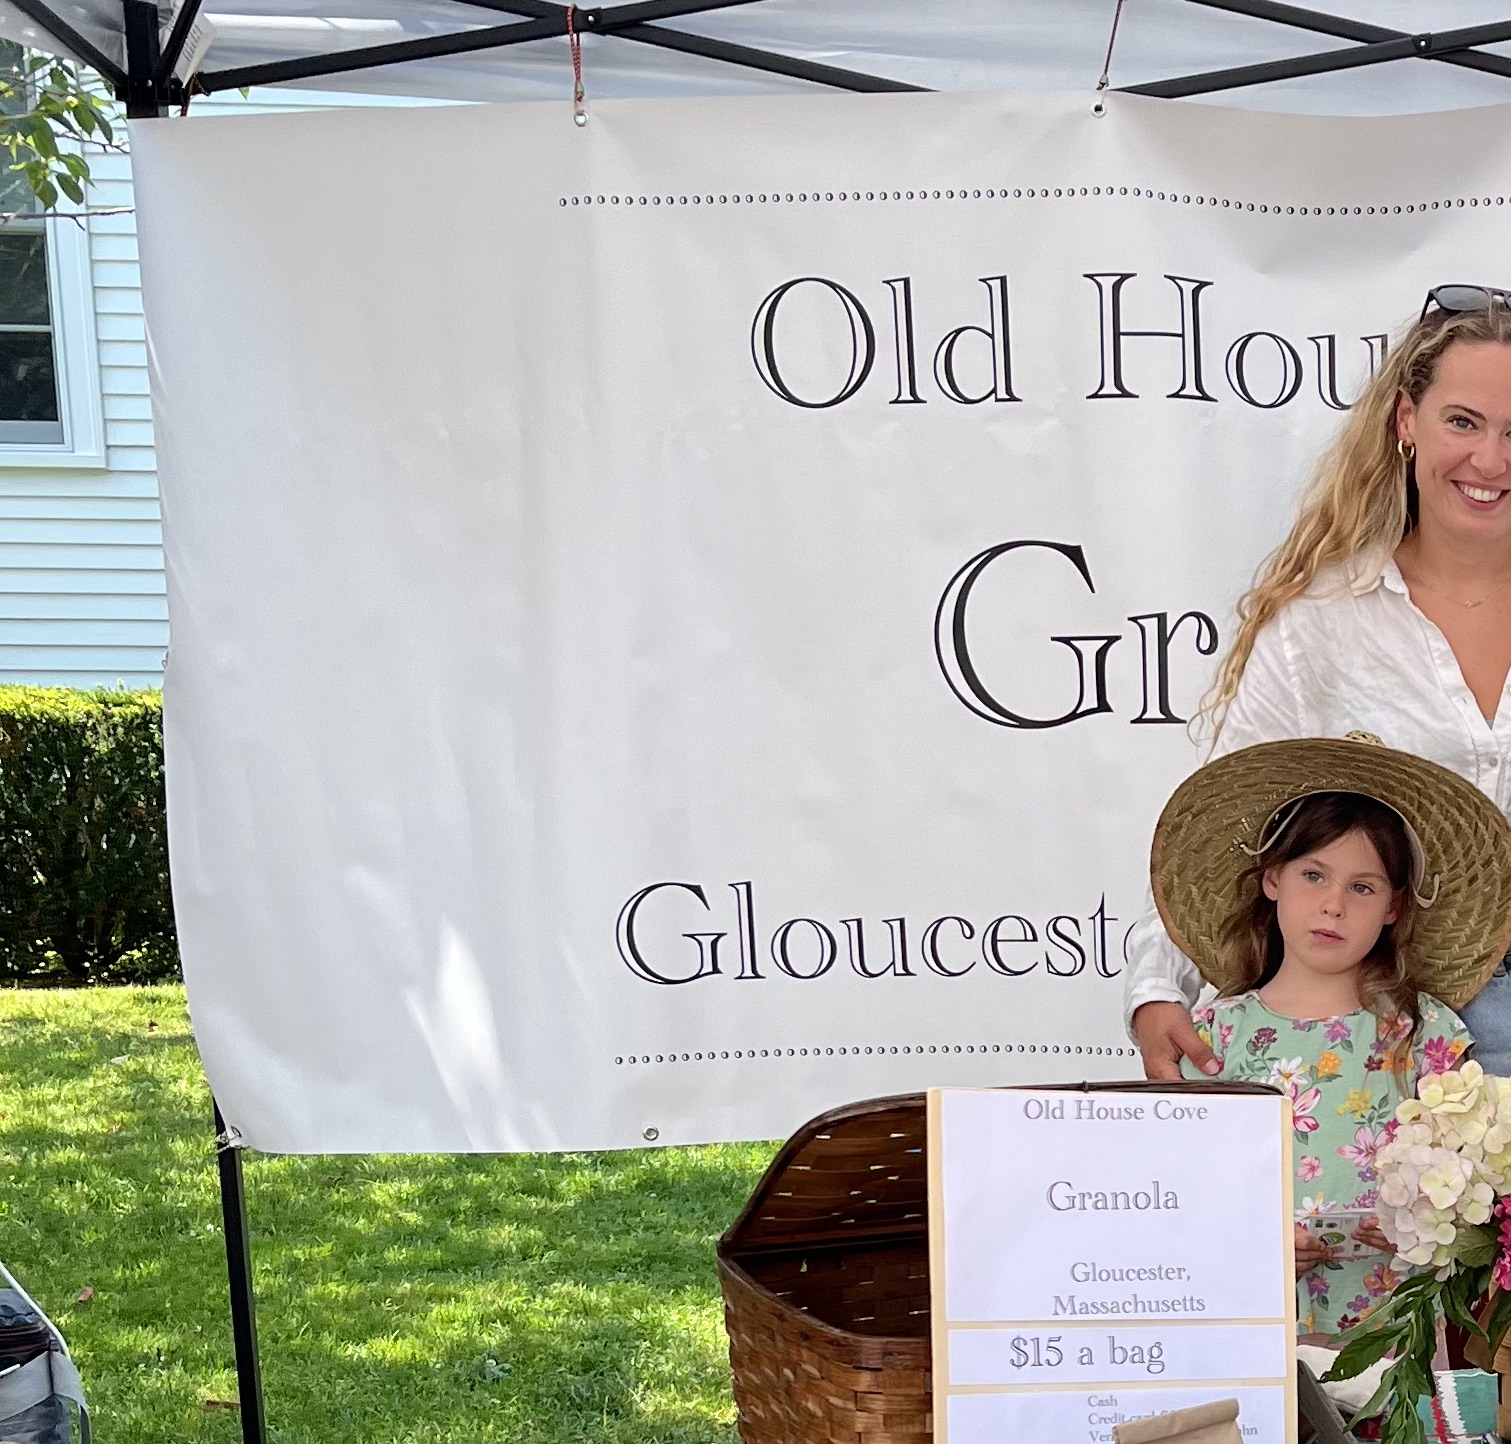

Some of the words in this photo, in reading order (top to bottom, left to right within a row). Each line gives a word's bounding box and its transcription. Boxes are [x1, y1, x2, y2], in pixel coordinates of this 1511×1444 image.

[751, 275, 1023, 408] Old
[1082, 273, 1388, 408] Hou
[616, 881, 1135, 984] Gloucest
[1023, 1099, 1065, 1121] Old
[1075, 1099, 1145, 1121] House
[1153, 1099, 1208, 1121] Cove
[1046, 1181, 1179, 1212] Granola
[1070, 1261, 1192, 1283] Gloucester,
[1052, 1294, 1205, 1316] Massachusetts
[1009, 1335, 1063, 1369] $15
[1077, 1345, 1095, 1367] a
[1108, 1335, 1165, 1374] bag
[1087, 1394, 1118, 1408] Cash
